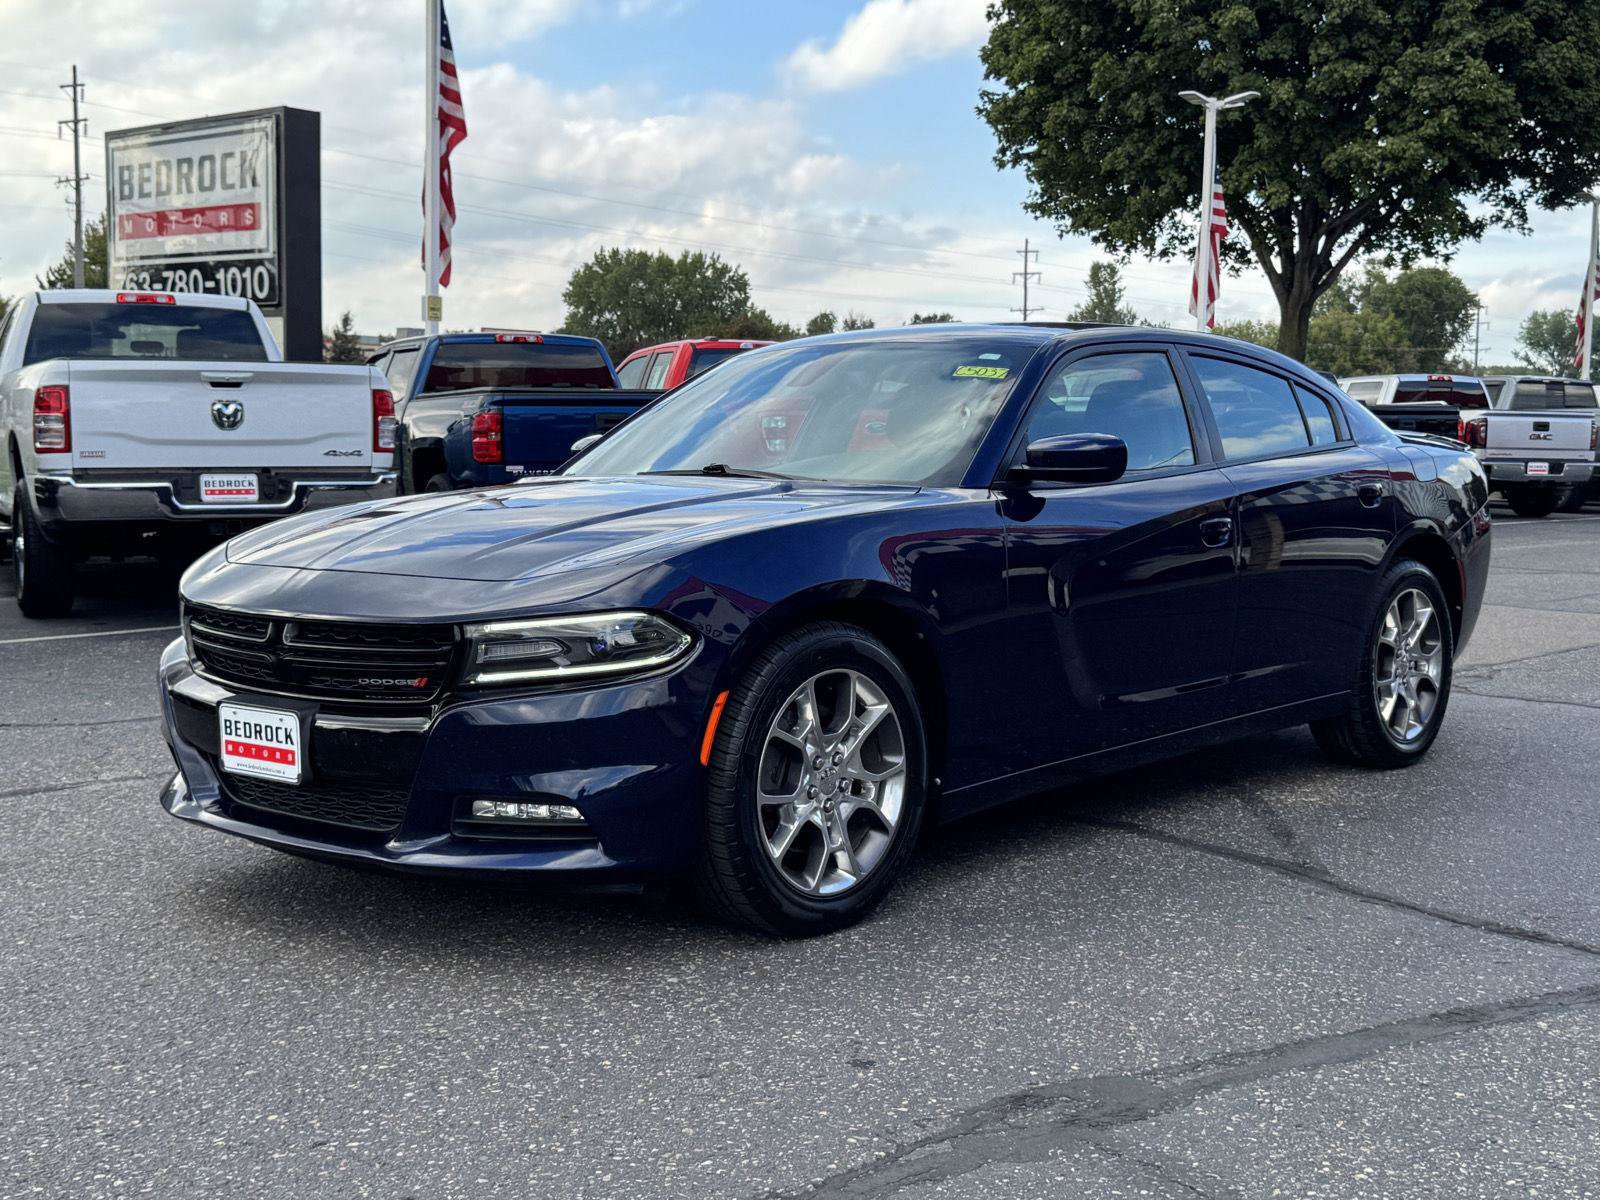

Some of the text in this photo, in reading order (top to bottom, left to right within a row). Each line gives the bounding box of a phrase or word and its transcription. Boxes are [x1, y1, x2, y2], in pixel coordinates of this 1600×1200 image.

[118, 150, 260, 201] BEDROCK
[124, 208, 254, 234] MOTORS
[122, 264, 270, 300] 63-780-1010
[204, 479, 255, 488] BEDROCK
[358, 678, 418, 687] DODGE
[223, 719, 295, 746] BEDROCK
[227, 743, 293, 762] MOTORS
